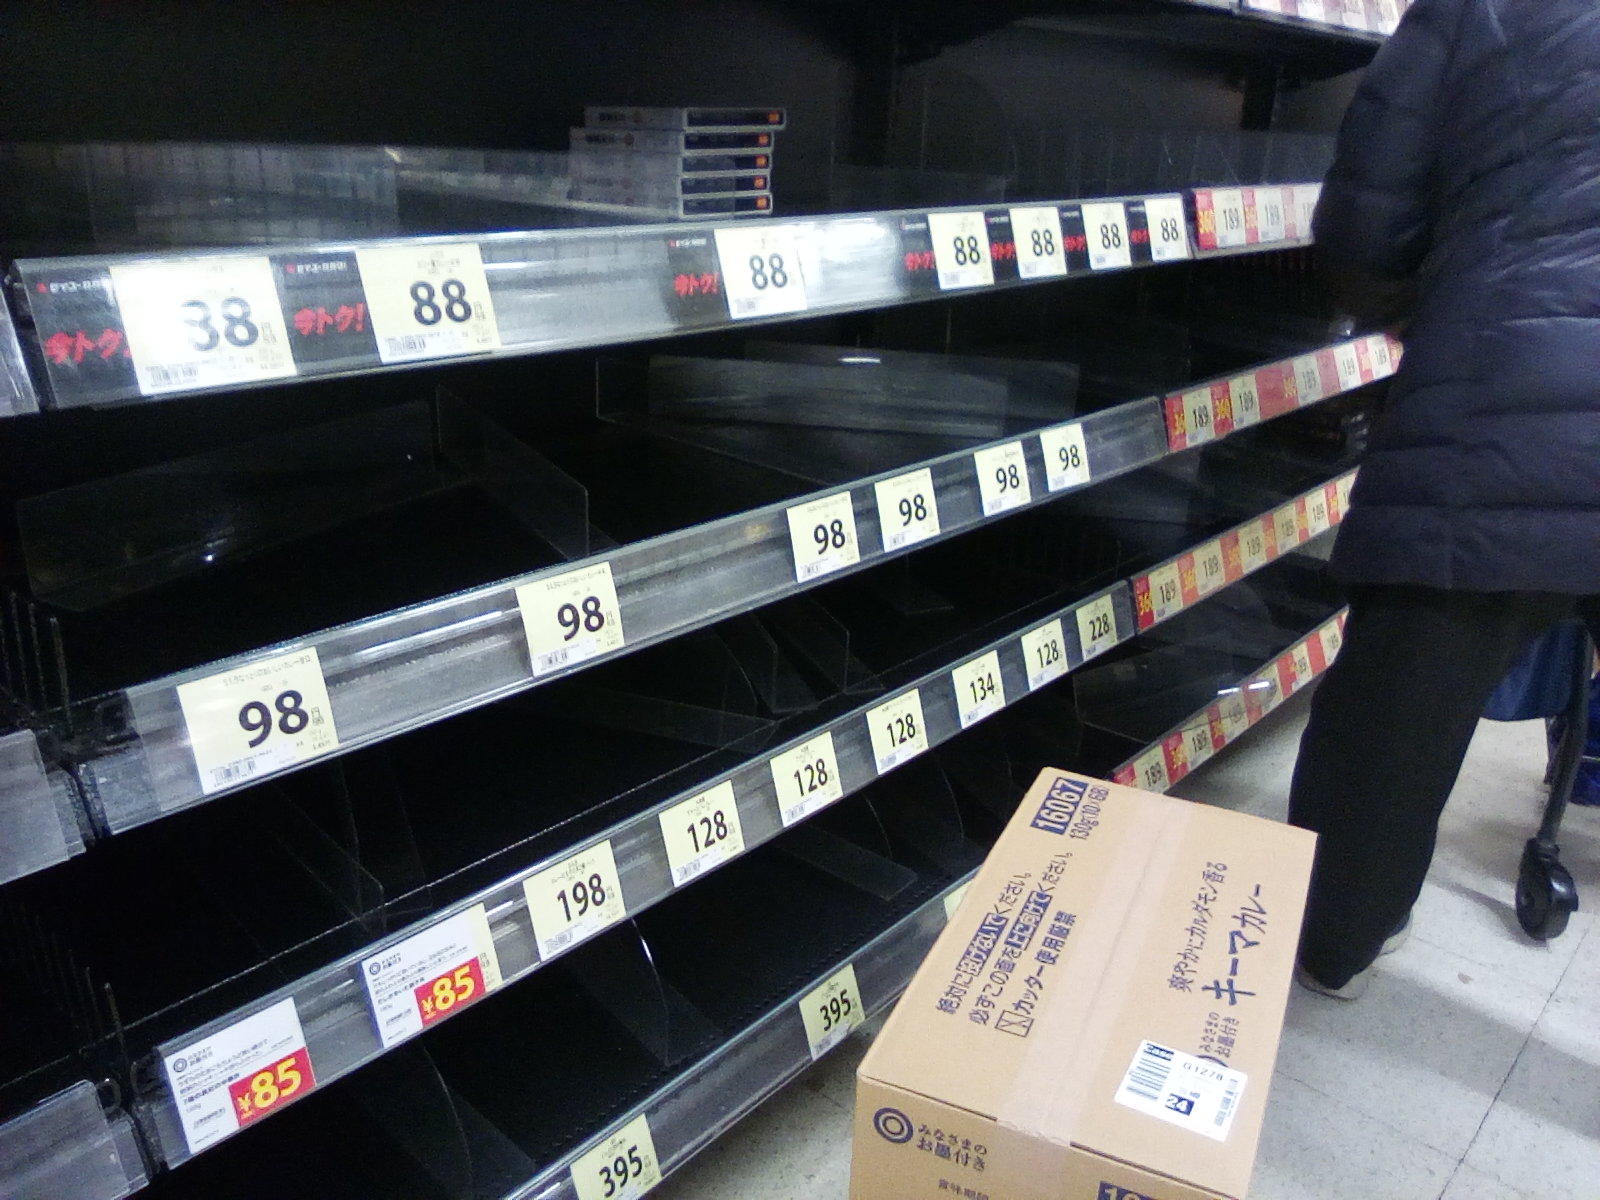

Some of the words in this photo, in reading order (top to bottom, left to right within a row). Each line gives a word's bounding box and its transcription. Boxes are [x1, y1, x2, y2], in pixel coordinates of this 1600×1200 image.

[1100, 223, 1121, 249] 88
[1160, 218, 1179, 242] 88
[1222, 208, 1239, 231] 189
[953, 236, 981, 265] 88
[1031, 229, 1055, 257] 88
[749, 253, 788, 290] 88
[409, 278, 472, 326] 88
[1193, 405, 1209, 429] 189
[1059, 444, 1081, 472] 98
[996, 464, 1021, 493] 98
[898, 493, 927, 528] 98
[813, 518, 847, 555] 98
[1203, 555, 1219, 578] 189
[1159, 580, 1176, 604] 189
[557, 595, 605, 642] 98
[1089, 613, 1110, 642] 228
[1037, 640, 1059, 669] 128
[970, 672, 995, 704] 134
[238, 689, 309, 749] 98
[886, 713, 916, 748] 128
[794, 758, 829, 797] 128
[1034, 777, 1086, 832] 16067
[687, 809, 729, 853] 128
[557, 873, 606, 923] 198
[1201, 884, 1267, 1006] キーマカレー
[422, 966, 475, 1013] ¥85
[820, 989, 852, 1031] 395
[238, 1058, 302, 1111] ¥85
[916, 1136, 986, 1172] お墨付き
[918, 1123, 988, 1155] みなさまの
[598, 1145, 643, 1199] 395
